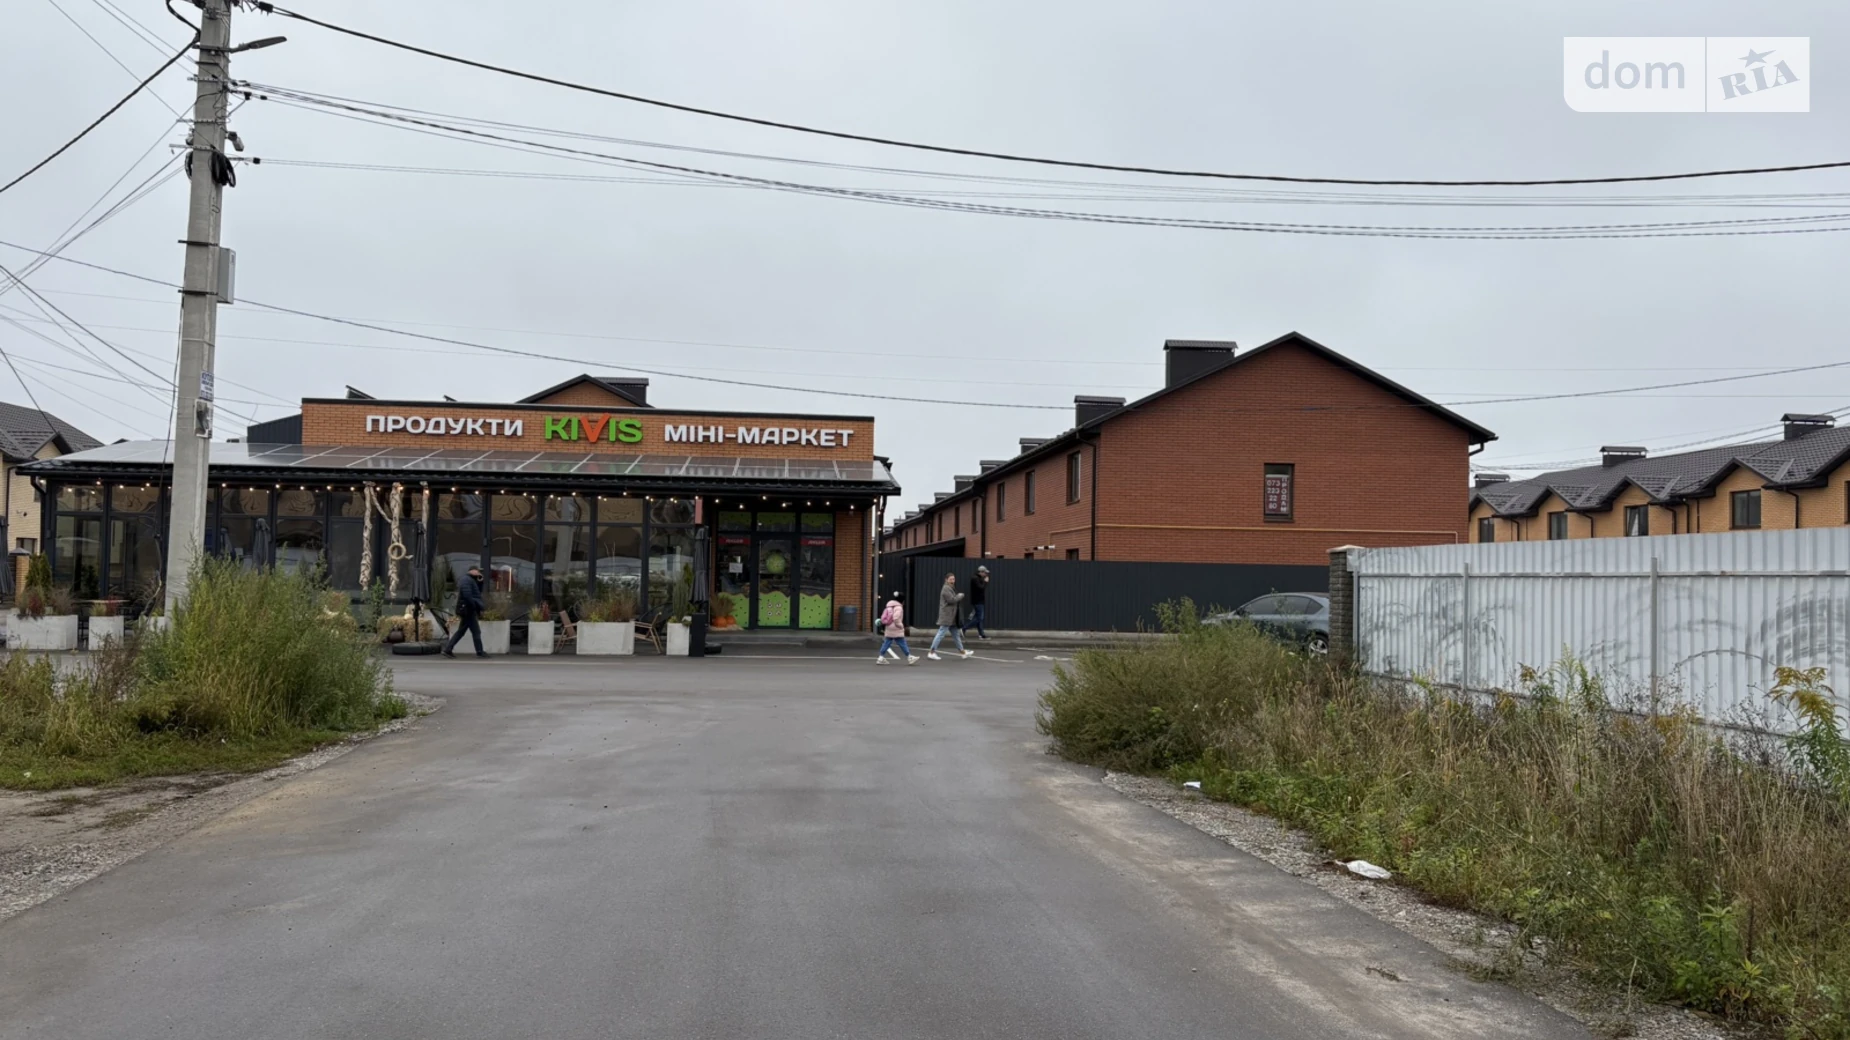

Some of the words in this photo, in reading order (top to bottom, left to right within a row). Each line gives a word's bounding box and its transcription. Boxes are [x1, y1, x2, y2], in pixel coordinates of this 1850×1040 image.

[365, 414, 524, 437] ПРОДУКТИ
[544, 412, 644, 443] KIVIS
[663, 424, 855, 447] МІНІ-МАРКЕТ
